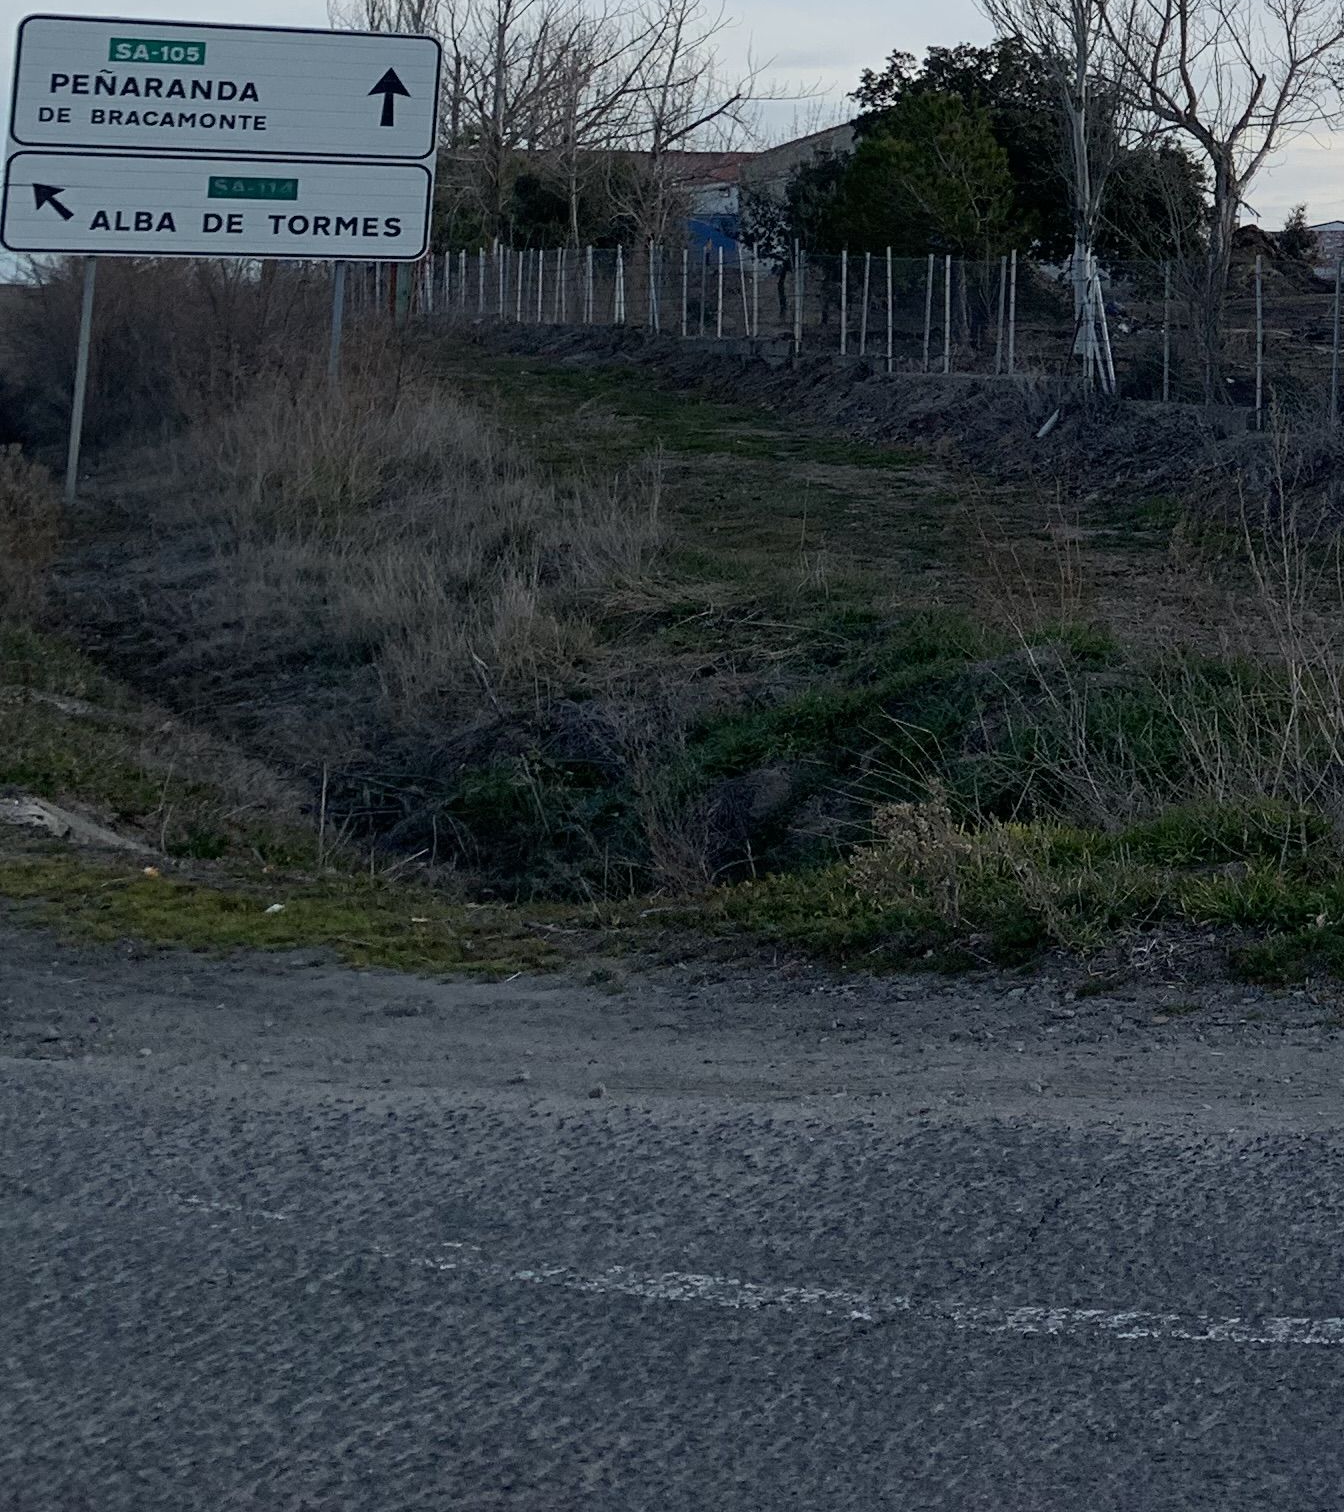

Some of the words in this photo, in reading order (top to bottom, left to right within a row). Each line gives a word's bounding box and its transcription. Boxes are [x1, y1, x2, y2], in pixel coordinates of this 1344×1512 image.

[115, 42, 200, 62] SA-105
[50, 69, 259, 102] PEÑARANDA
[38, 107, 71, 123] DE
[91, 110, 267, 131] BRACAMONTE
[90, 209, 176, 233] ALBA
[203, 213, 243, 234] DE
[269, 215, 401, 237] TORMES
